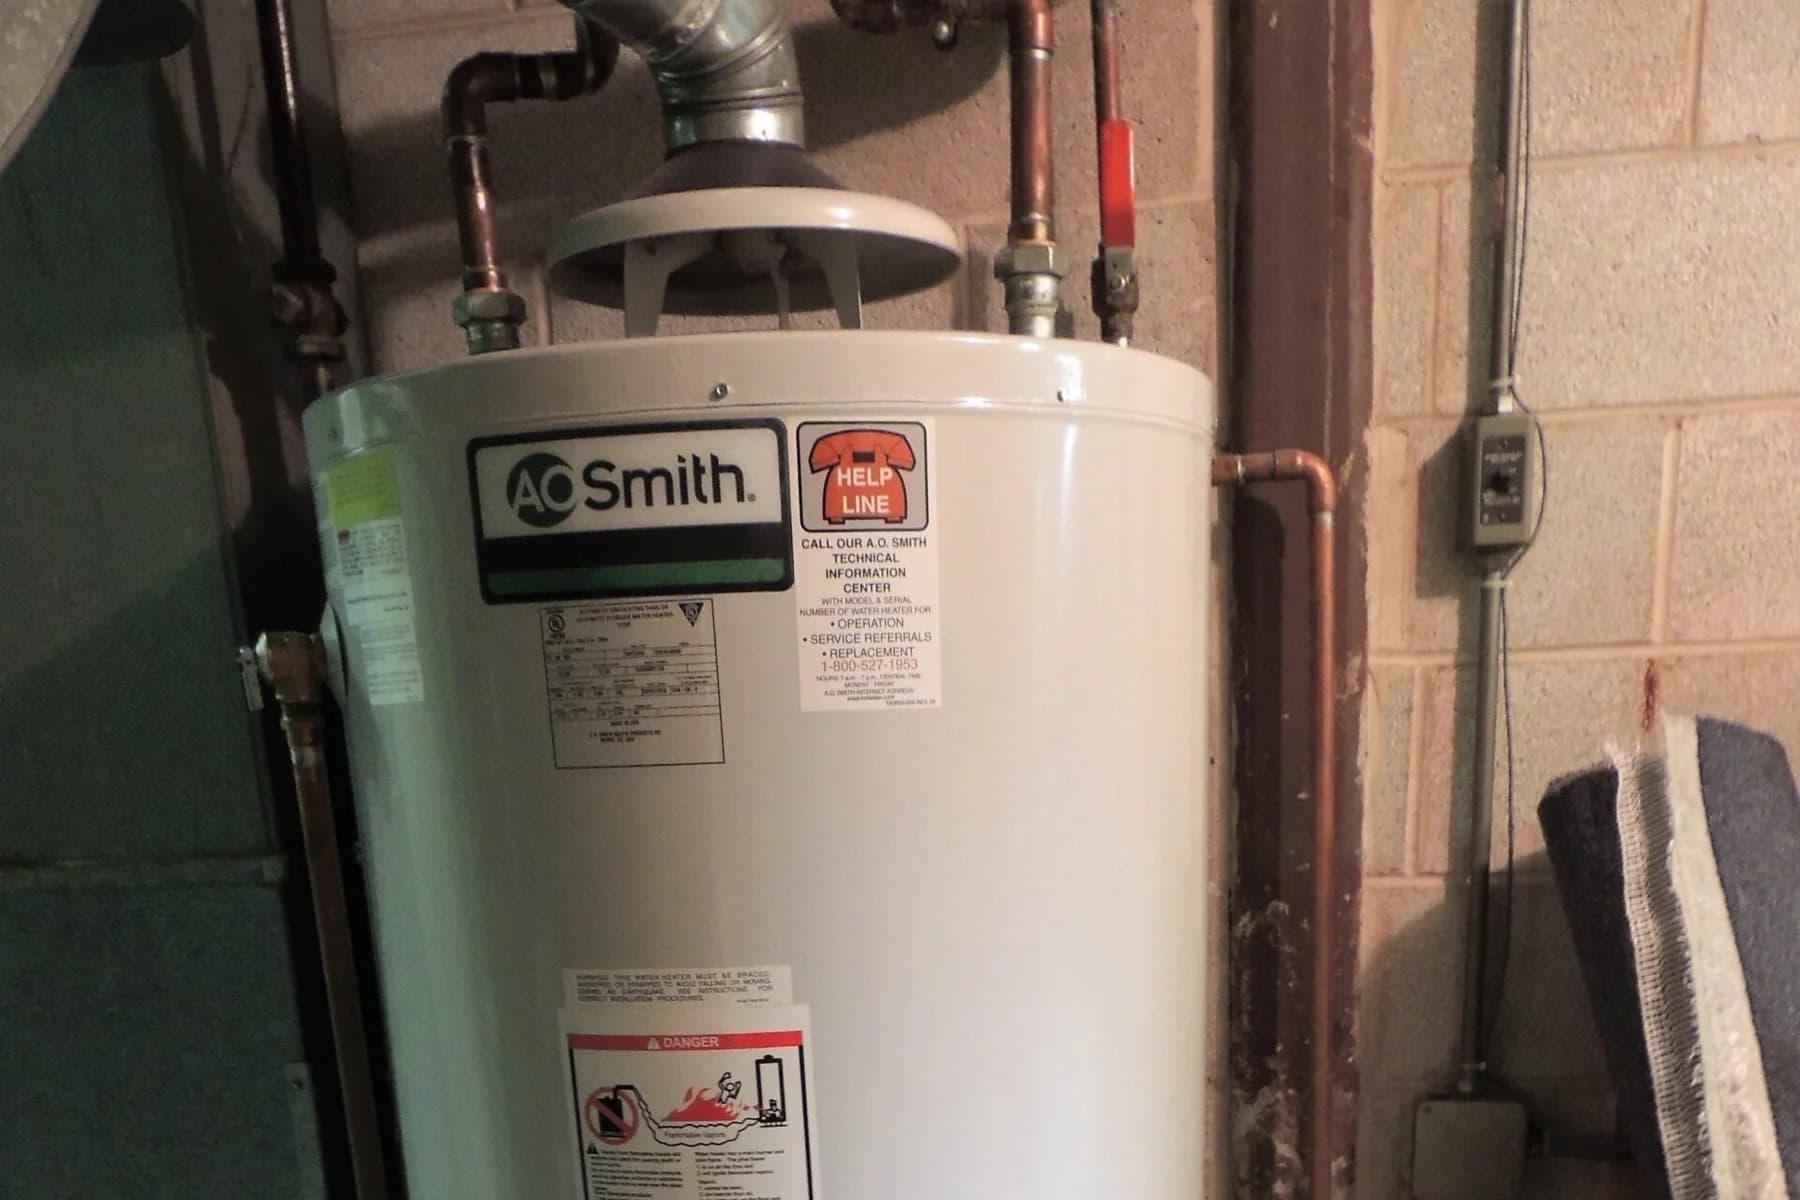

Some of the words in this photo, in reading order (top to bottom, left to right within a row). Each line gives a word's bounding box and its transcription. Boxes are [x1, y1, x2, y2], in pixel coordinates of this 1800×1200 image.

[837, 467, 893, 487] HELP
[843, 495, 890, 514] LINE
[801, 538, 833, 549] CALL
[836, 537, 863, 549] OUR
[866, 537, 889, 548] A.O.
[892, 537, 927, 548] SMITH
[832, 552, 900, 564] TECHNICAL
[825, 567, 906, 579] INFORMATION
[843, 583, 891, 594] CENTER
[821, 597, 843, 606] WITH
[845, 597, 873, 605] MODEL
[883, 596, 912, 604] SERIAL
[800, 608, 836, 617] NUMBER
[837, 607, 849, 616] OF
[851, 607, 880, 616] WATER
[881, 606, 913, 615] HEATER
[914, 606, 931, 614] FOR
[837, 618, 904, 629] OPERATION
[810, 633, 861, 645] SERVICE
[864, 632, 932, 643] REFERRALS
[830, 647, 915, 659] REPLACEMENT
[822, 658, 918, 673] 1-800-527-1953
[663, 1036, 719, 1049] DANGER
